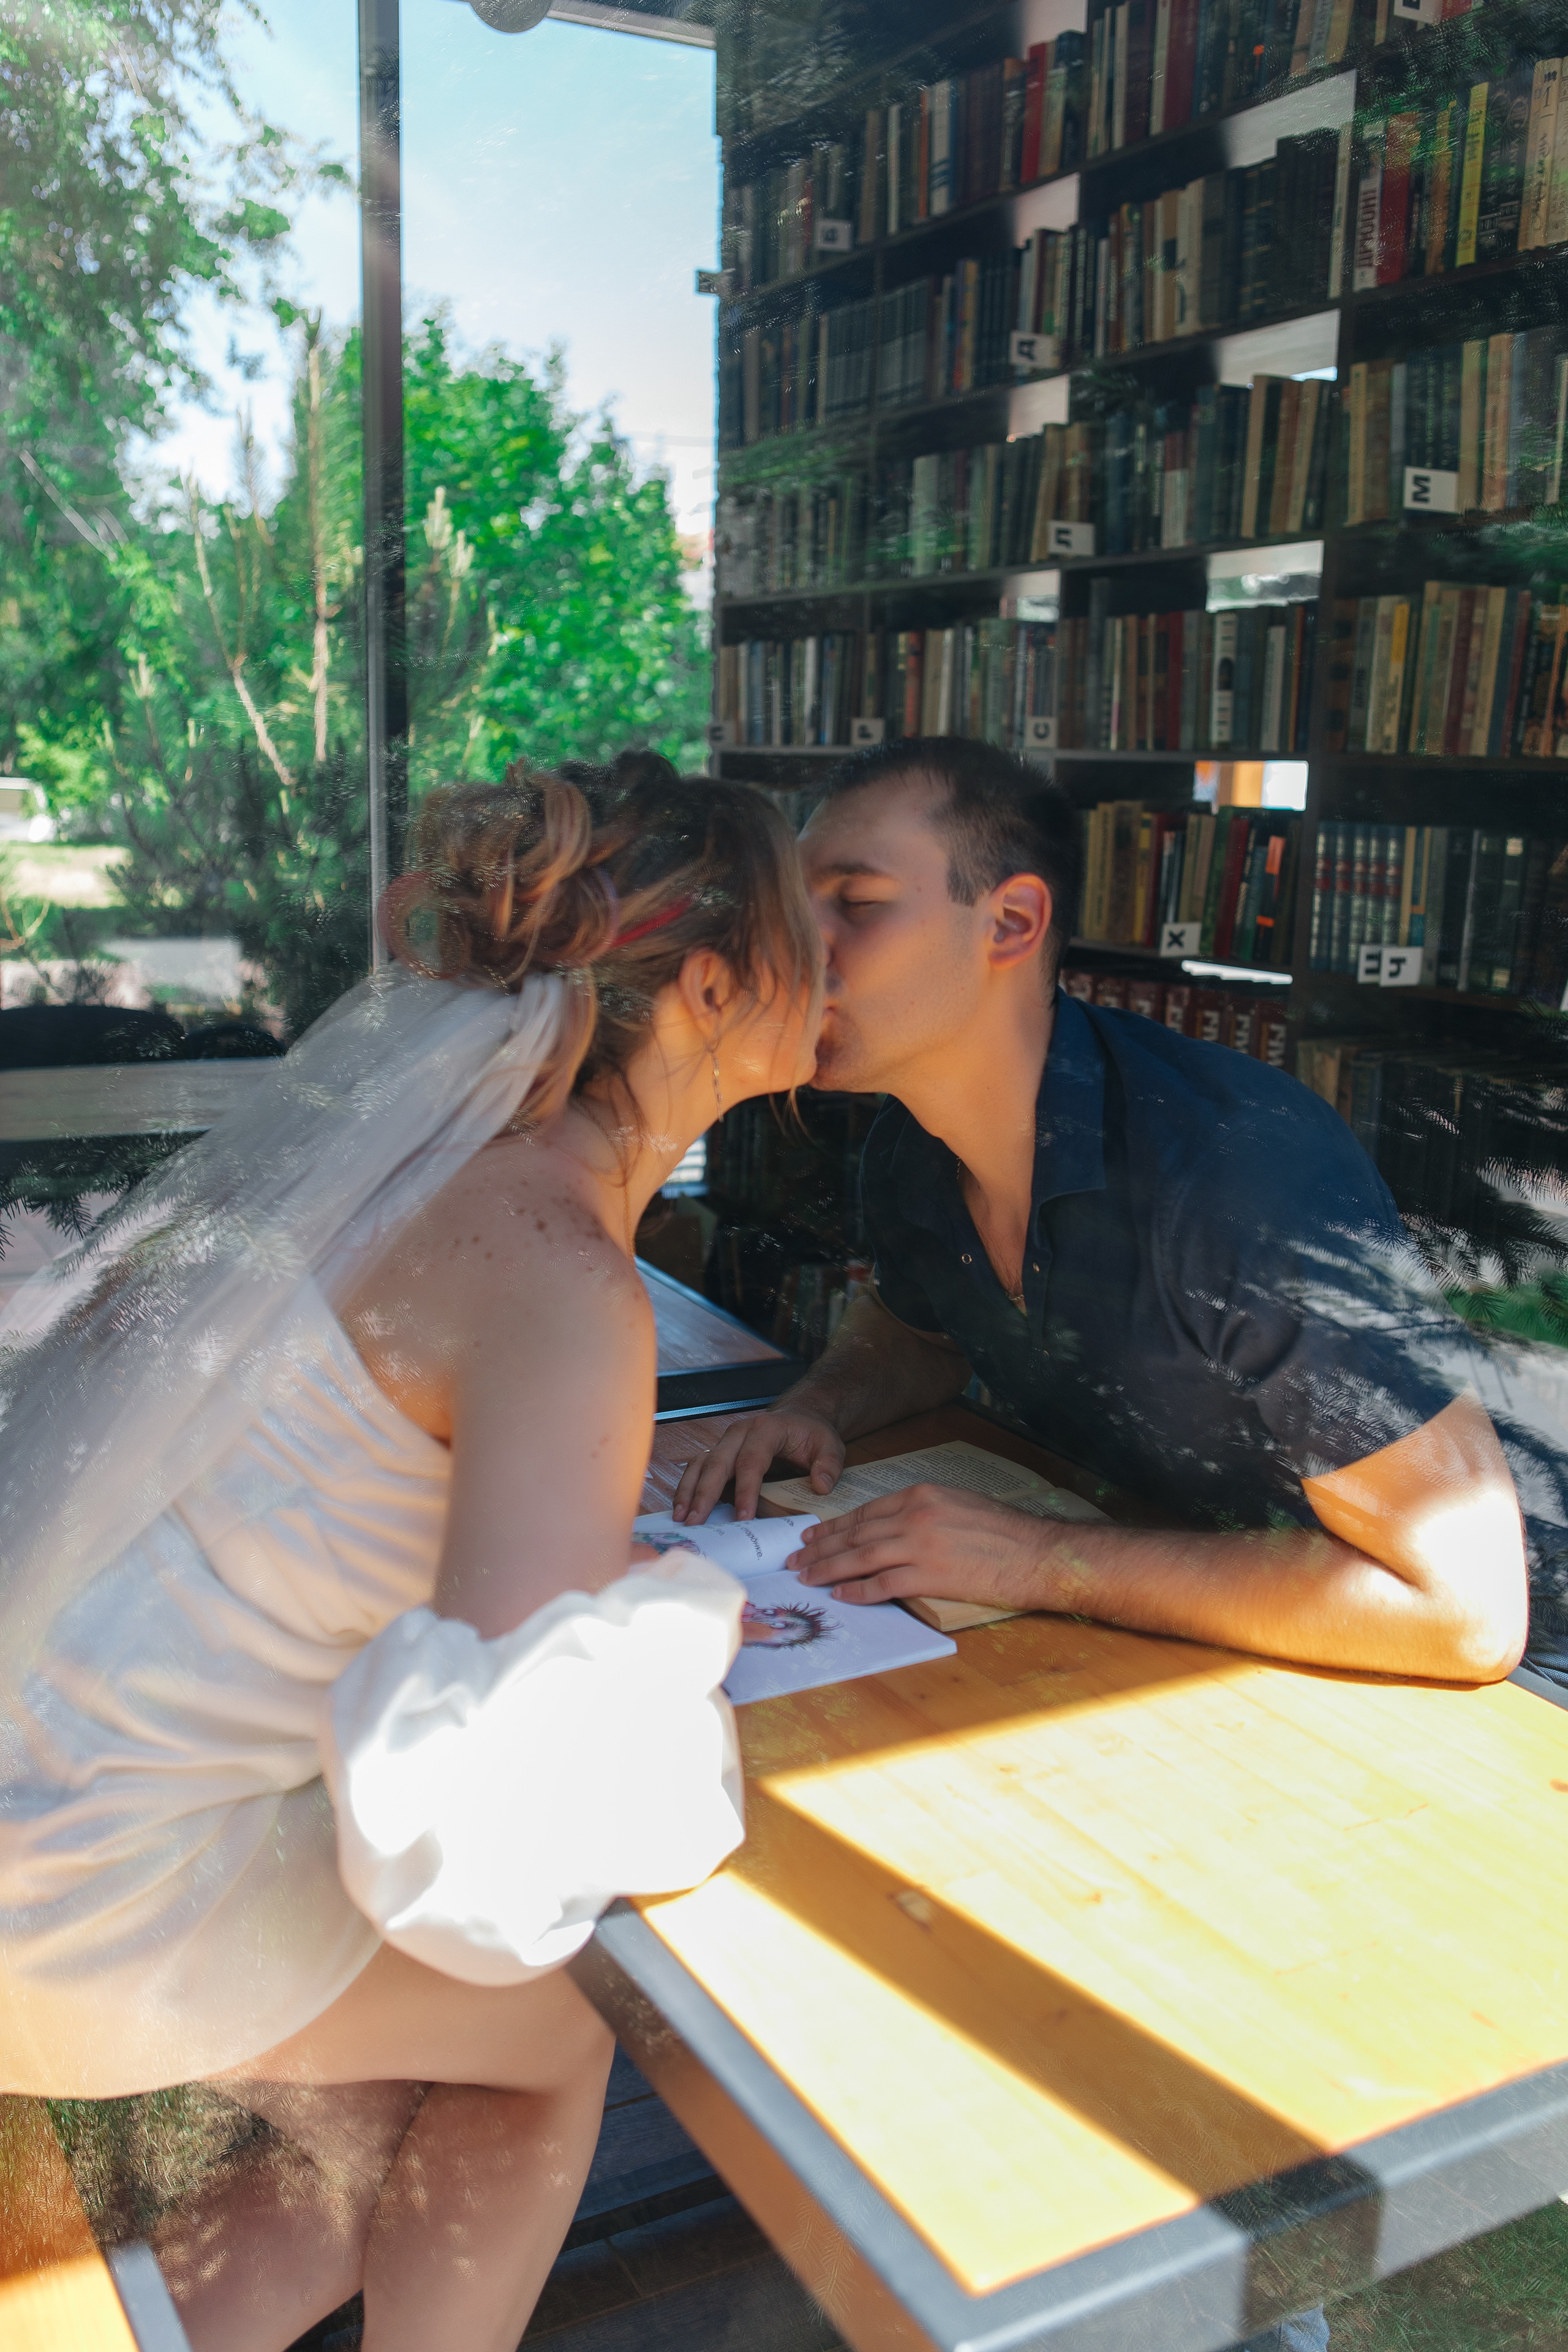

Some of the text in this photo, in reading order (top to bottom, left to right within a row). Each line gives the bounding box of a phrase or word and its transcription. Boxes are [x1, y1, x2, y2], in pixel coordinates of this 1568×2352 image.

[1411, 475, 1431, 504] М
[1033, 722, 1050, 741] С
[1167, 930, 1185, 948] Х
[1388, 957, 1408, 979] Ч
